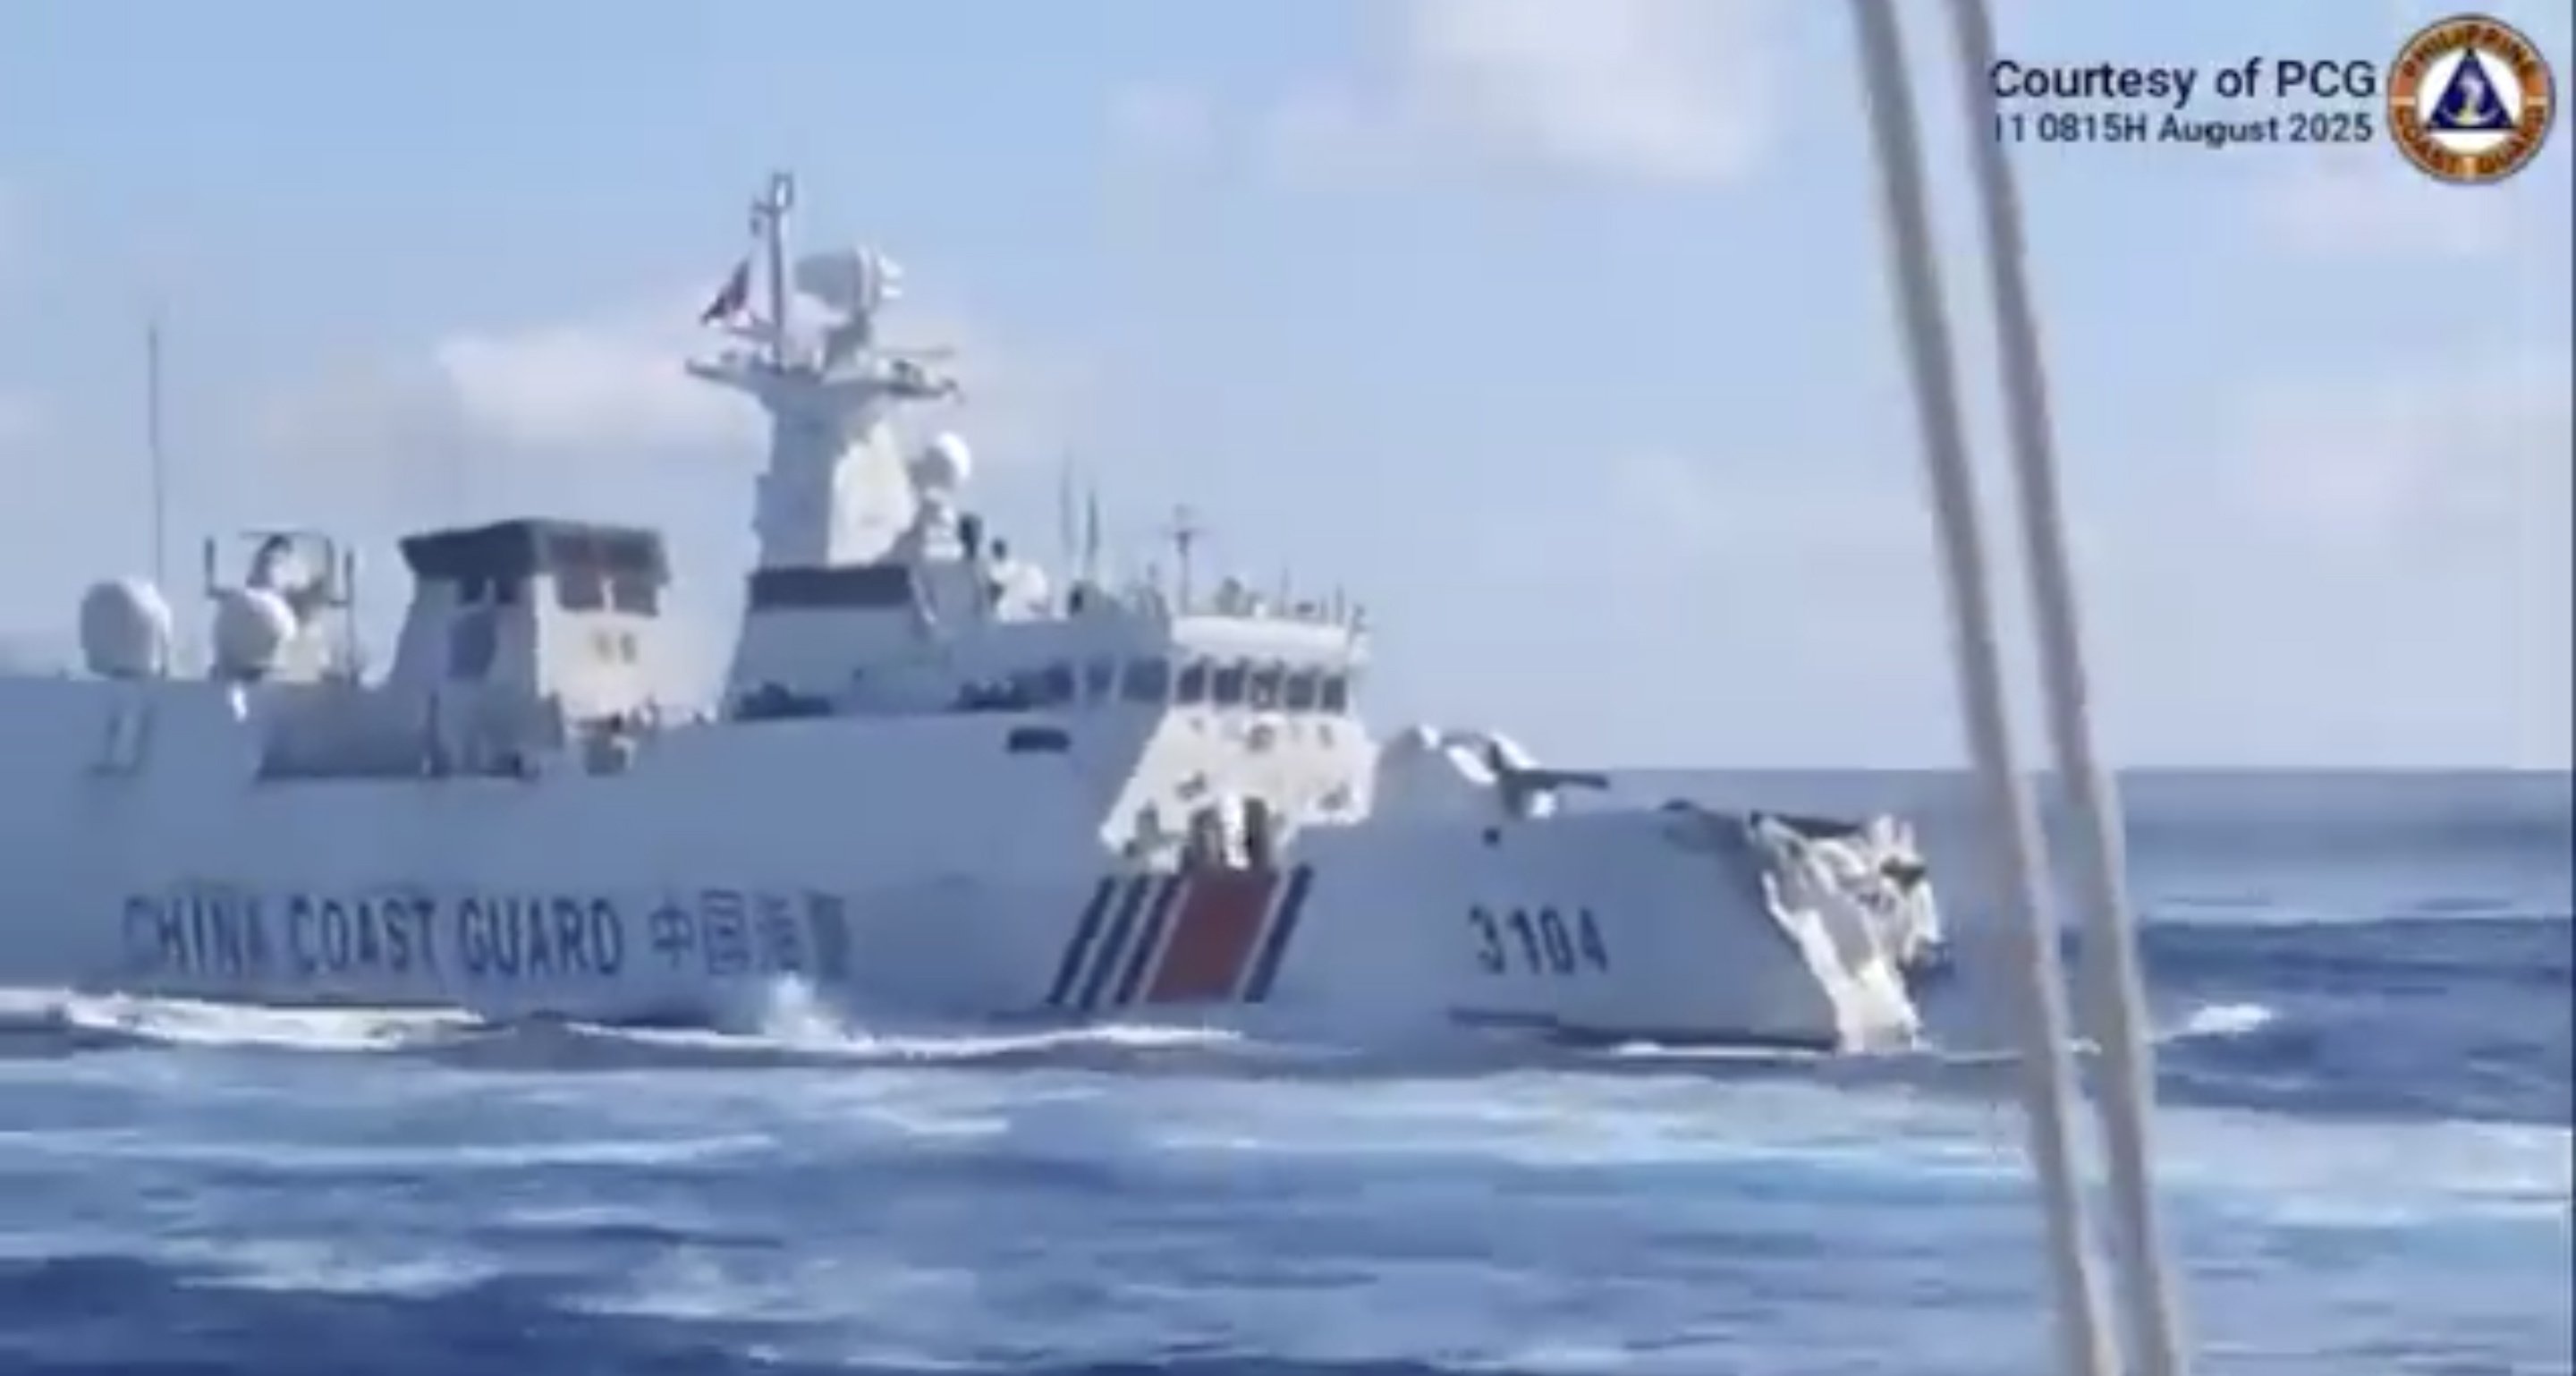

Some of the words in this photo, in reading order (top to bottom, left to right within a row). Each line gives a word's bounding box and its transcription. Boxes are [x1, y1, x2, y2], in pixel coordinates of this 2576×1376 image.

[122, 893, 268, 975] CHINA
[288, 895, 440, 975] COAST
[458, 896, 626, 977] GUARD
[647, 888, 853, 982] 中国海
[1468, 903, 1608, 975] 3104
